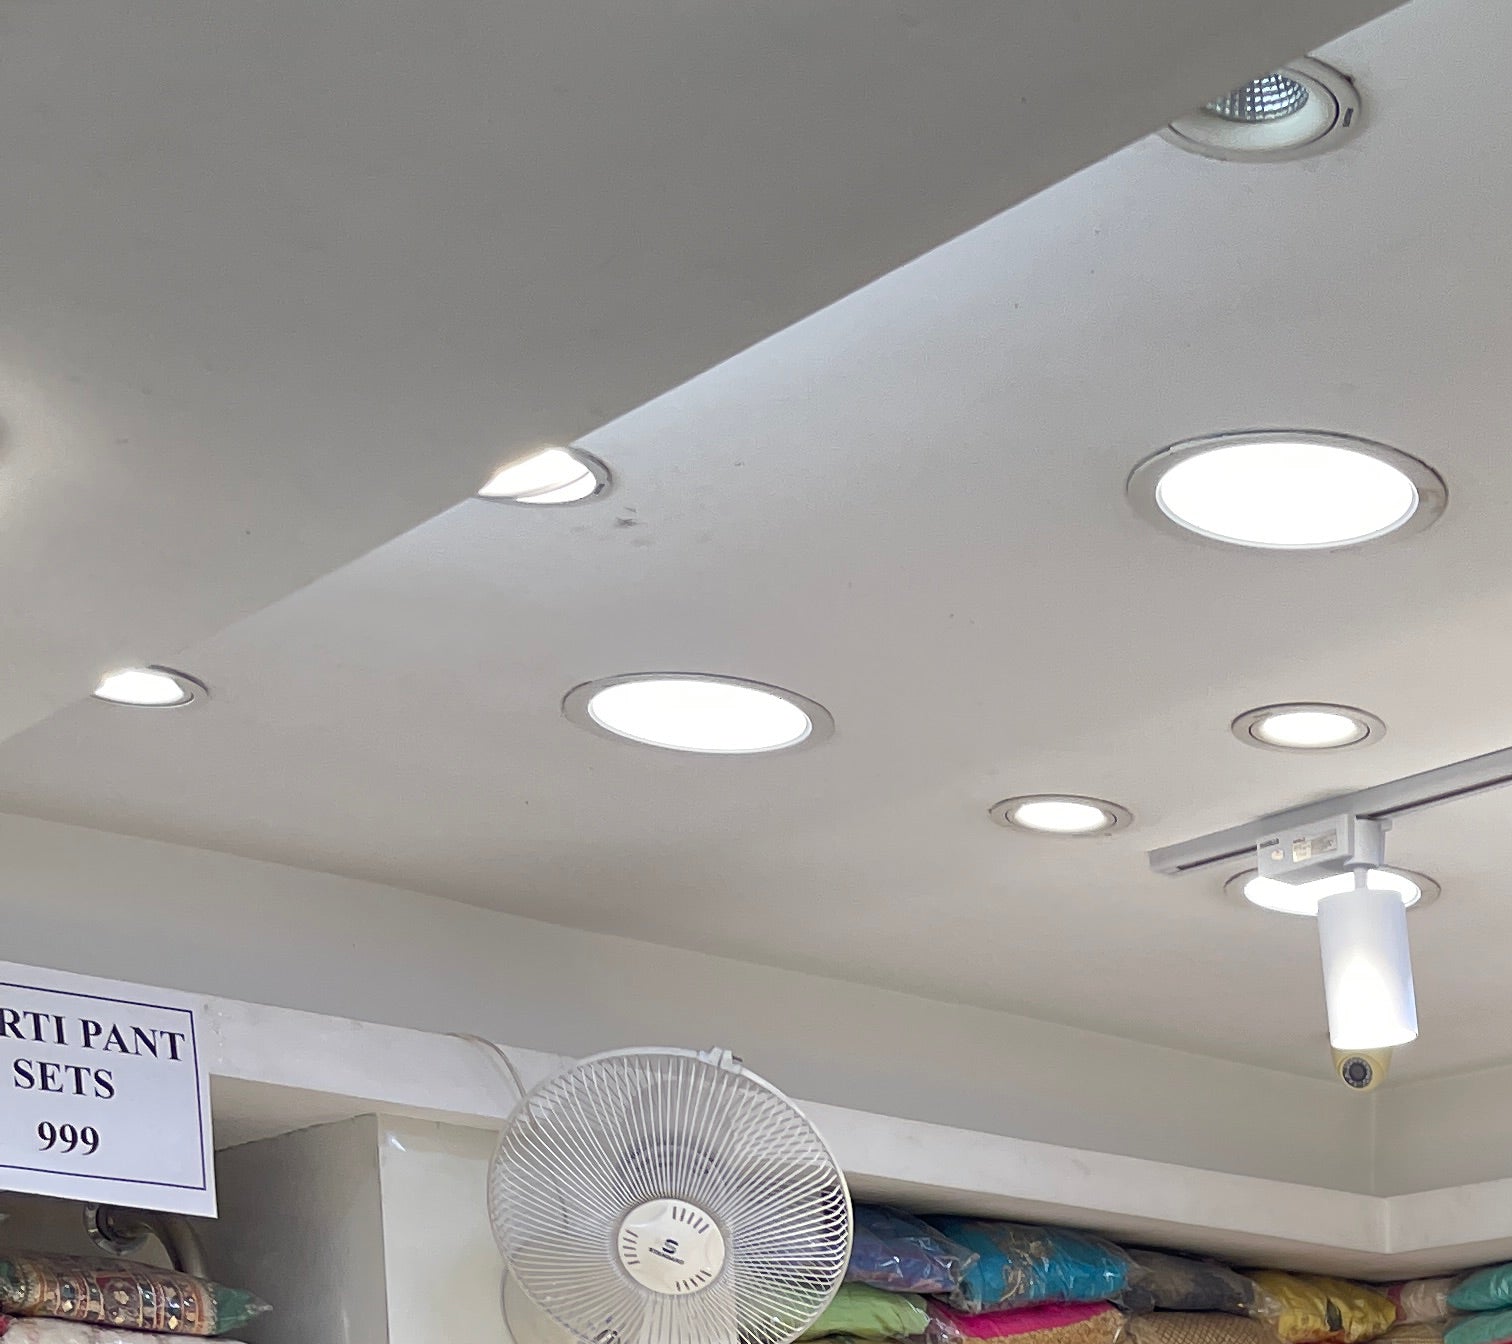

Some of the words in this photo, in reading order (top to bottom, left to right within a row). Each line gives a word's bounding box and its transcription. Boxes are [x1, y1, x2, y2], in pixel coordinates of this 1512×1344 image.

[80, 1017, 186, 1062] PANT
[13, 1057, 115, 1100] SETS
[37, 1121, 100, 1155] 999
